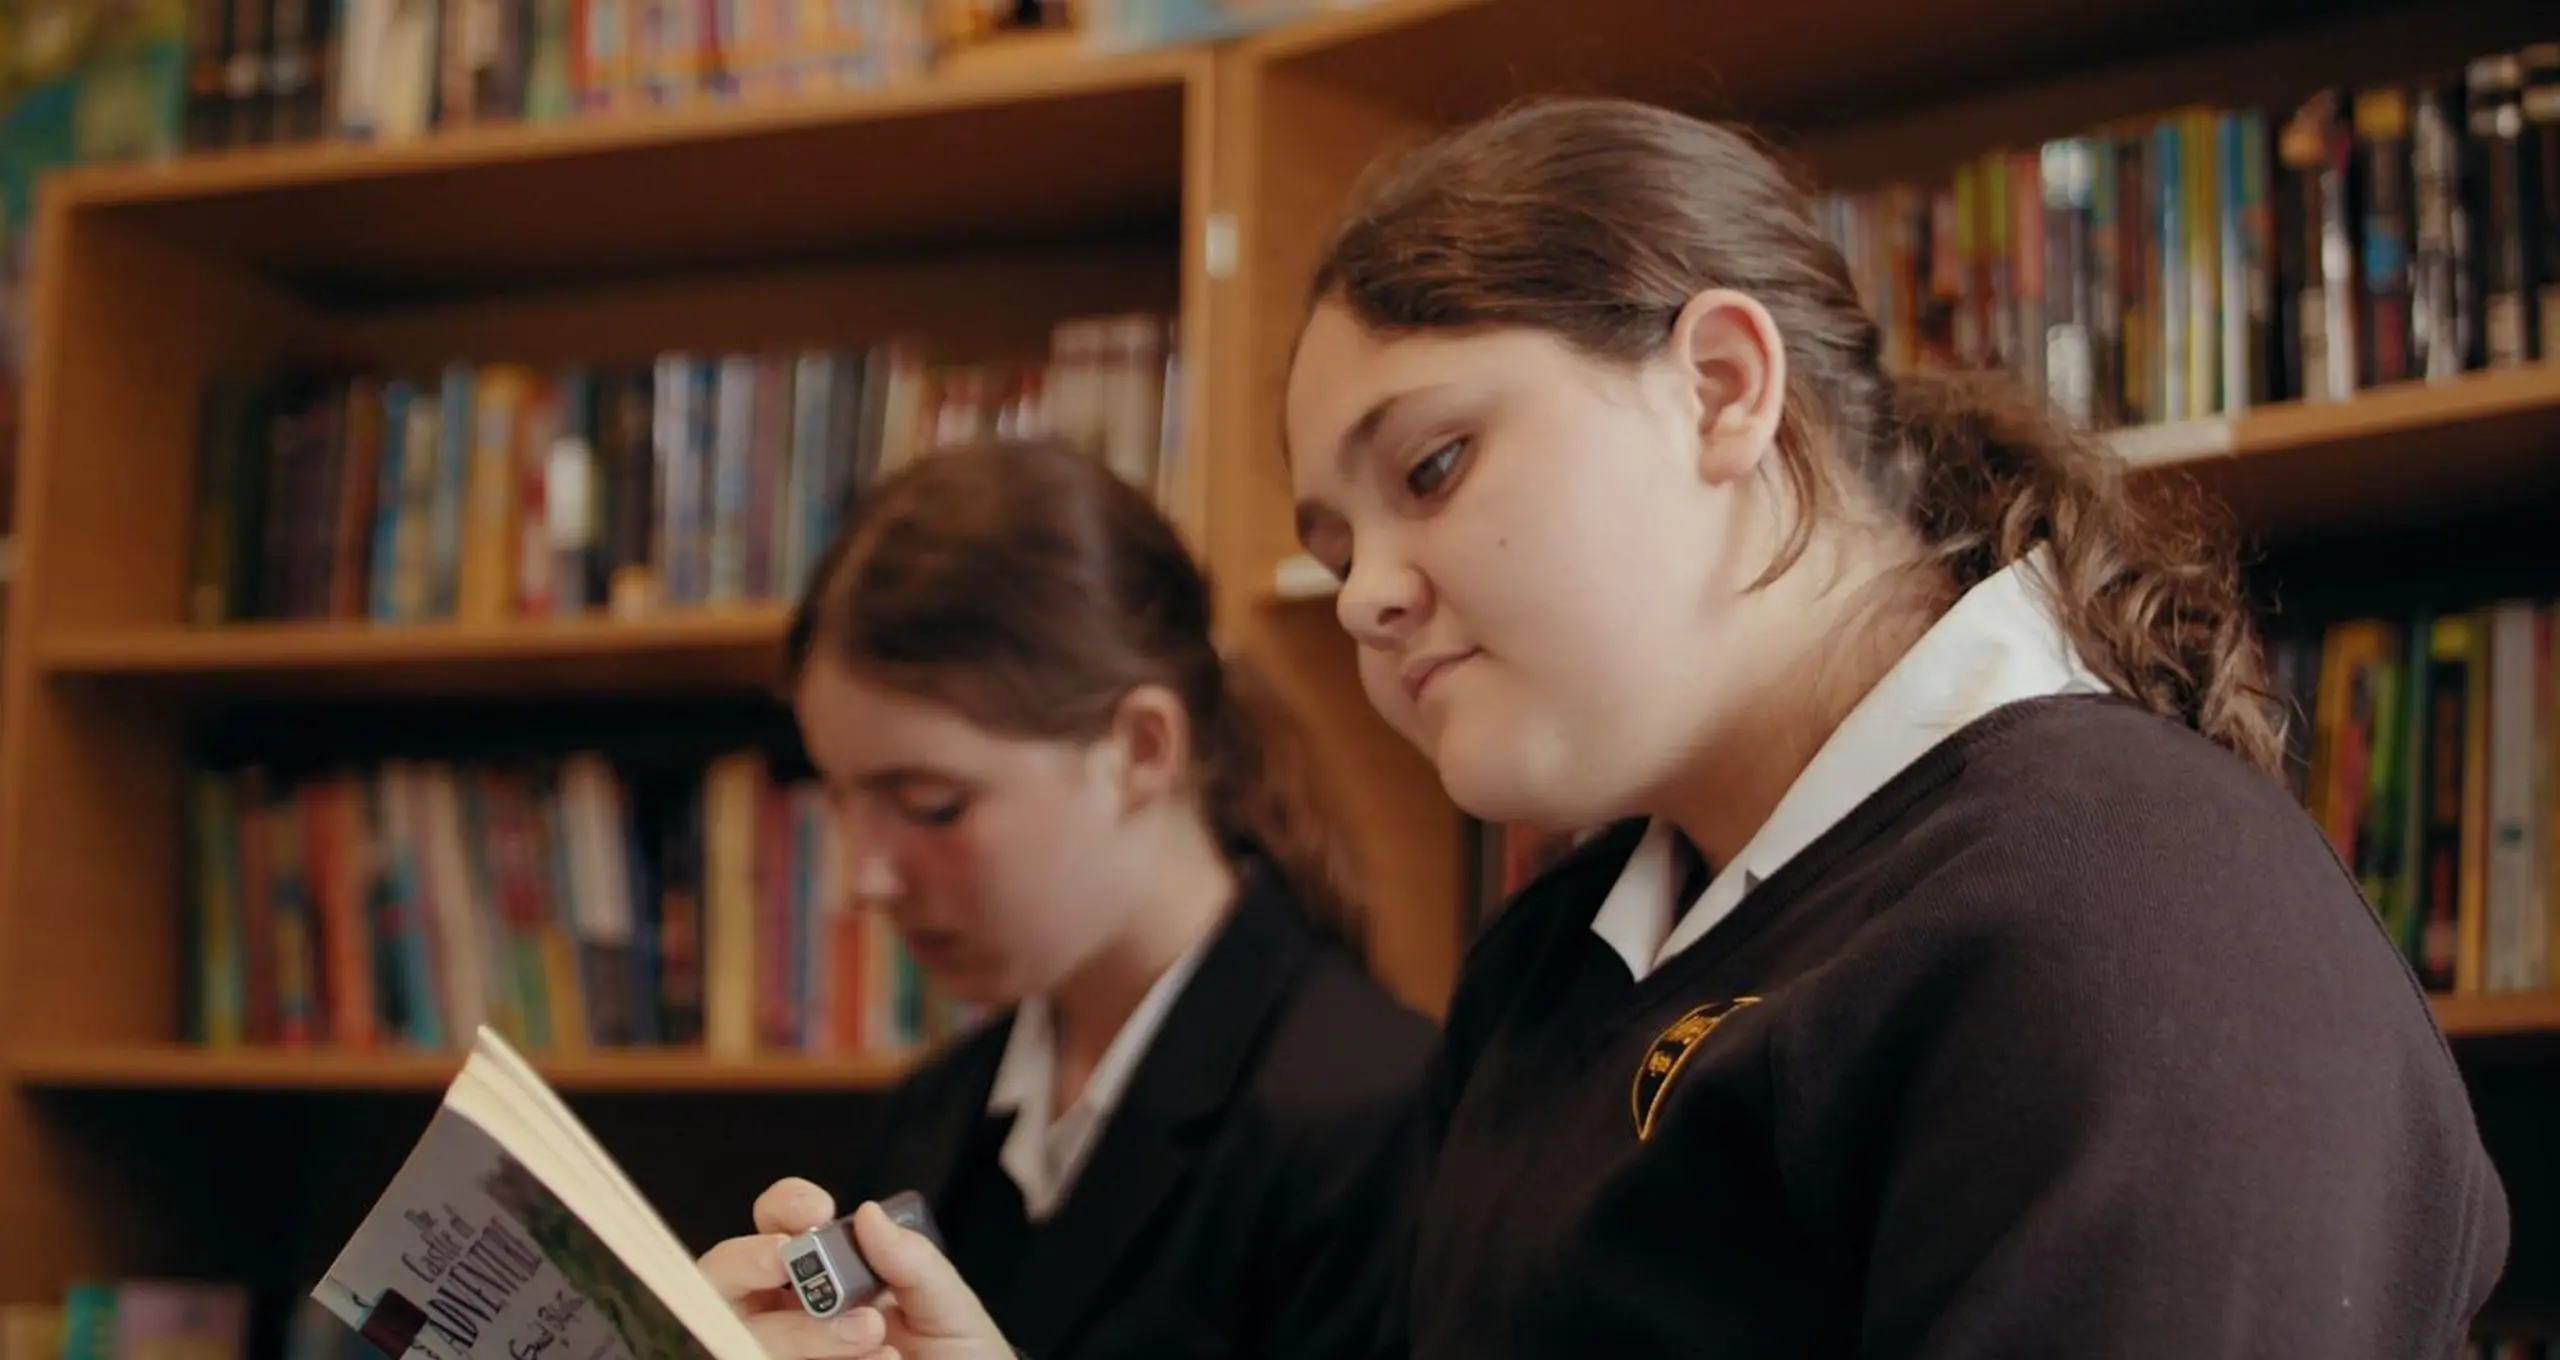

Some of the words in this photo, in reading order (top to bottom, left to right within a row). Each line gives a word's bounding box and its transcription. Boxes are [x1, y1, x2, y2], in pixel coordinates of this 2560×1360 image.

[402, 1230, 463, 1283] Castle
[443, 1203, 475, 1239] of
[425, 1216, 543, 1352] ADVENTURE
